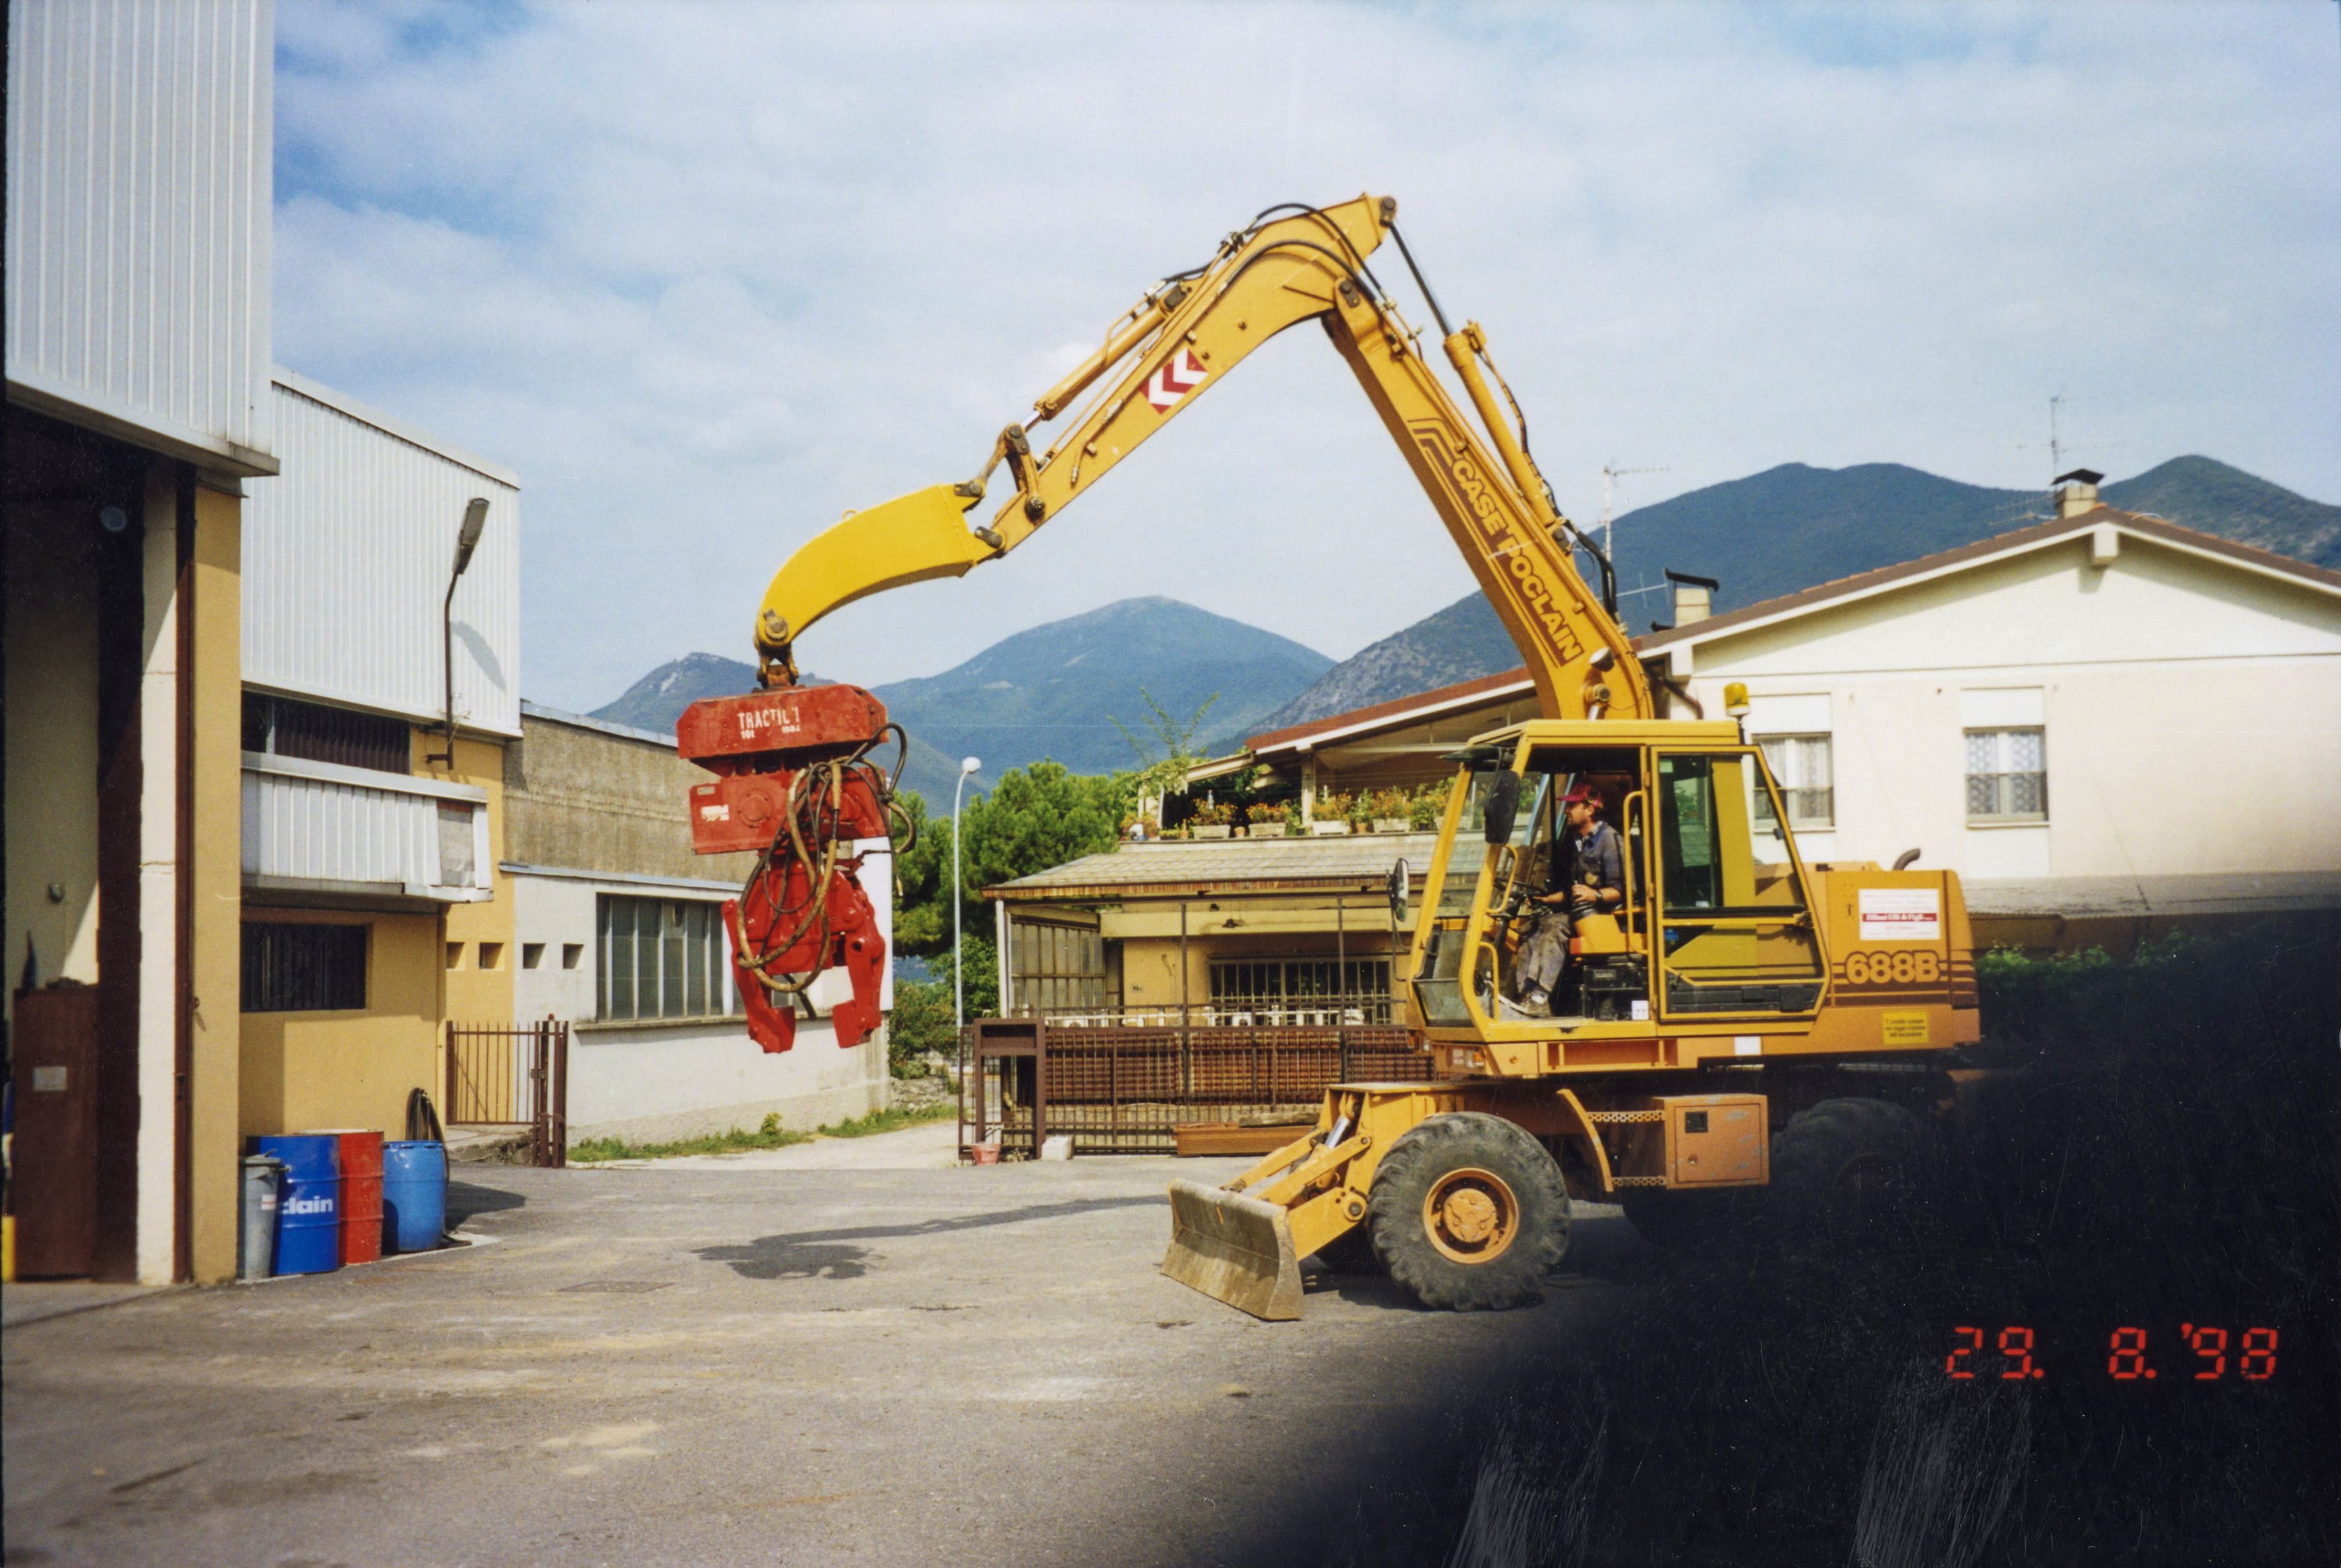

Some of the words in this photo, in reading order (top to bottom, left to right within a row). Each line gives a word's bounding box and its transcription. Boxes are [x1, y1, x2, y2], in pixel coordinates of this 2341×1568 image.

[1453, 459, 1508, 536] CASE
[1497, 535, 1584, 661] POCLAIN
[737, 708, 790, 729] TRACTIL
[1846, 950, 1940, 984] 688B
